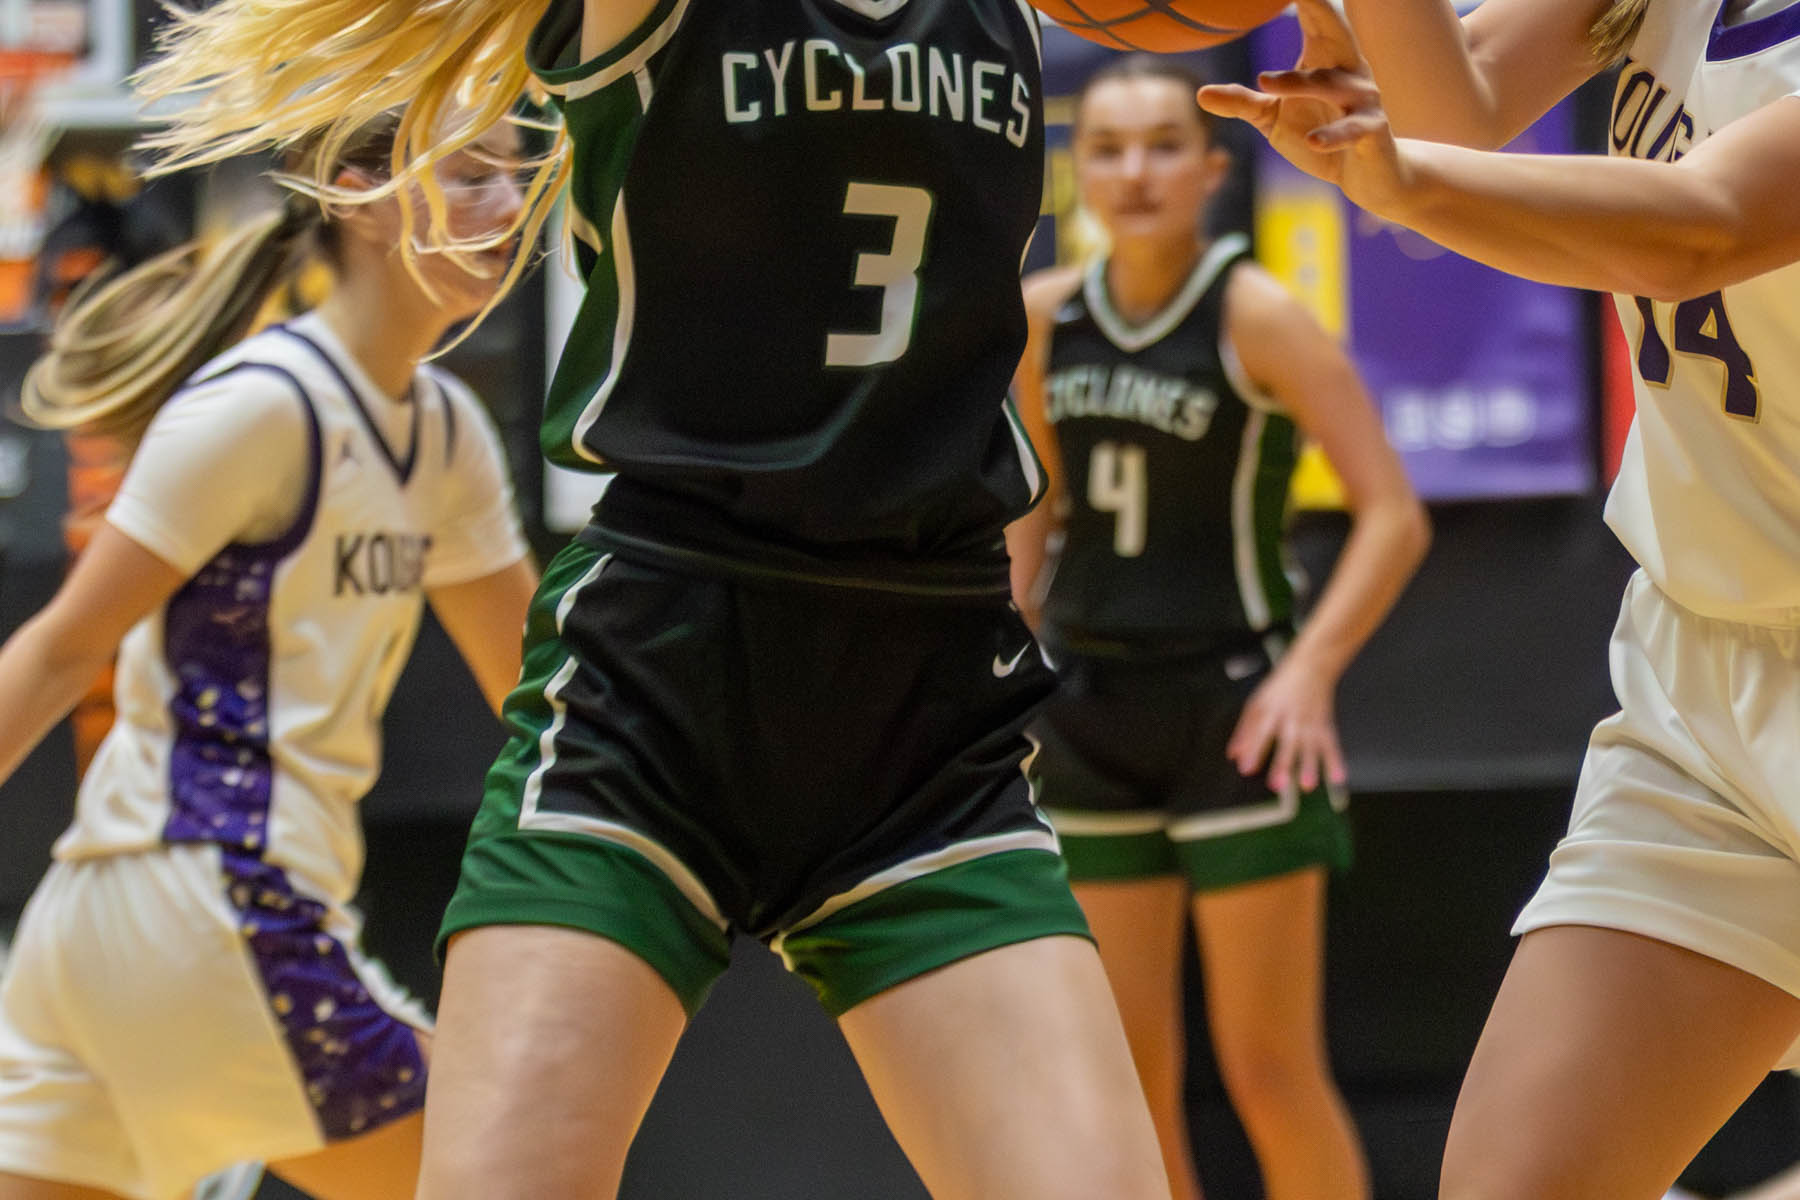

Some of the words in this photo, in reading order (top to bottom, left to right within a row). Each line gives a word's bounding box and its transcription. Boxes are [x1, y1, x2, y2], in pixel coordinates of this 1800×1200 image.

[722, 39, 1031, 149] CYCLONES
[825, 182, 933, 367] 3
[1088, 442, 1148, 557] 4
